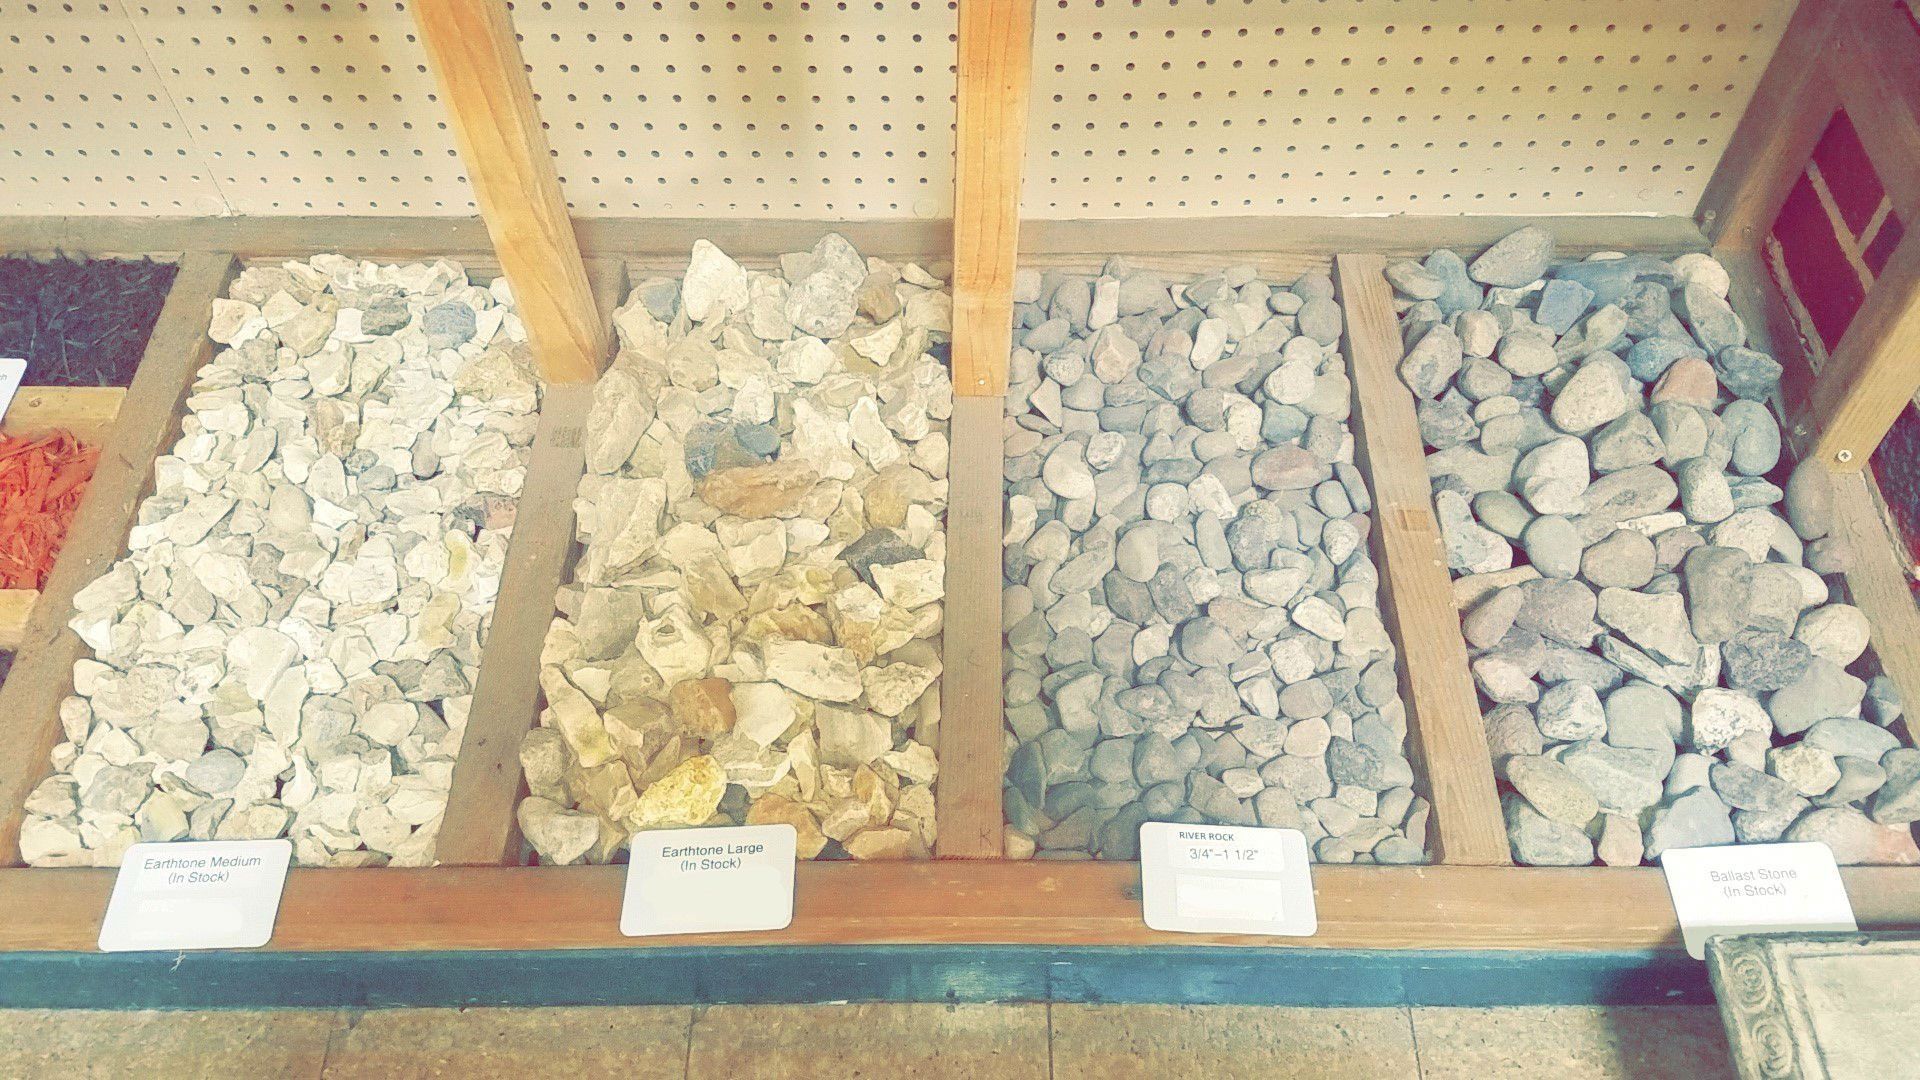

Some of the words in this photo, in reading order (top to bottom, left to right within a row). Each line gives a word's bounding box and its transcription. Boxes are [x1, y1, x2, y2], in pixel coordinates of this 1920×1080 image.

[1179, 831, 1207, 841] RIVER
[1208, 832, 1235, 842] ROCK
[662, 846, 724, 858] Earthtone
[727, 843, 764, 856] Large
[144, 857, 206, 870] Earthtone
[209, 855, 262, 868] Medium
[680, 859, 697, 873] (In
[701, 857, 742, 871] Stock)
[168, 871, 185, 885] (In
[187, 870, 230, 884] Stock)
[1710, 870, 1756, 883] Ballast
[1758, 868, 1798, 880] Stone
[1723, 885, 1741, 899] (In
[1744, 883, 1787, 898] Stock)
